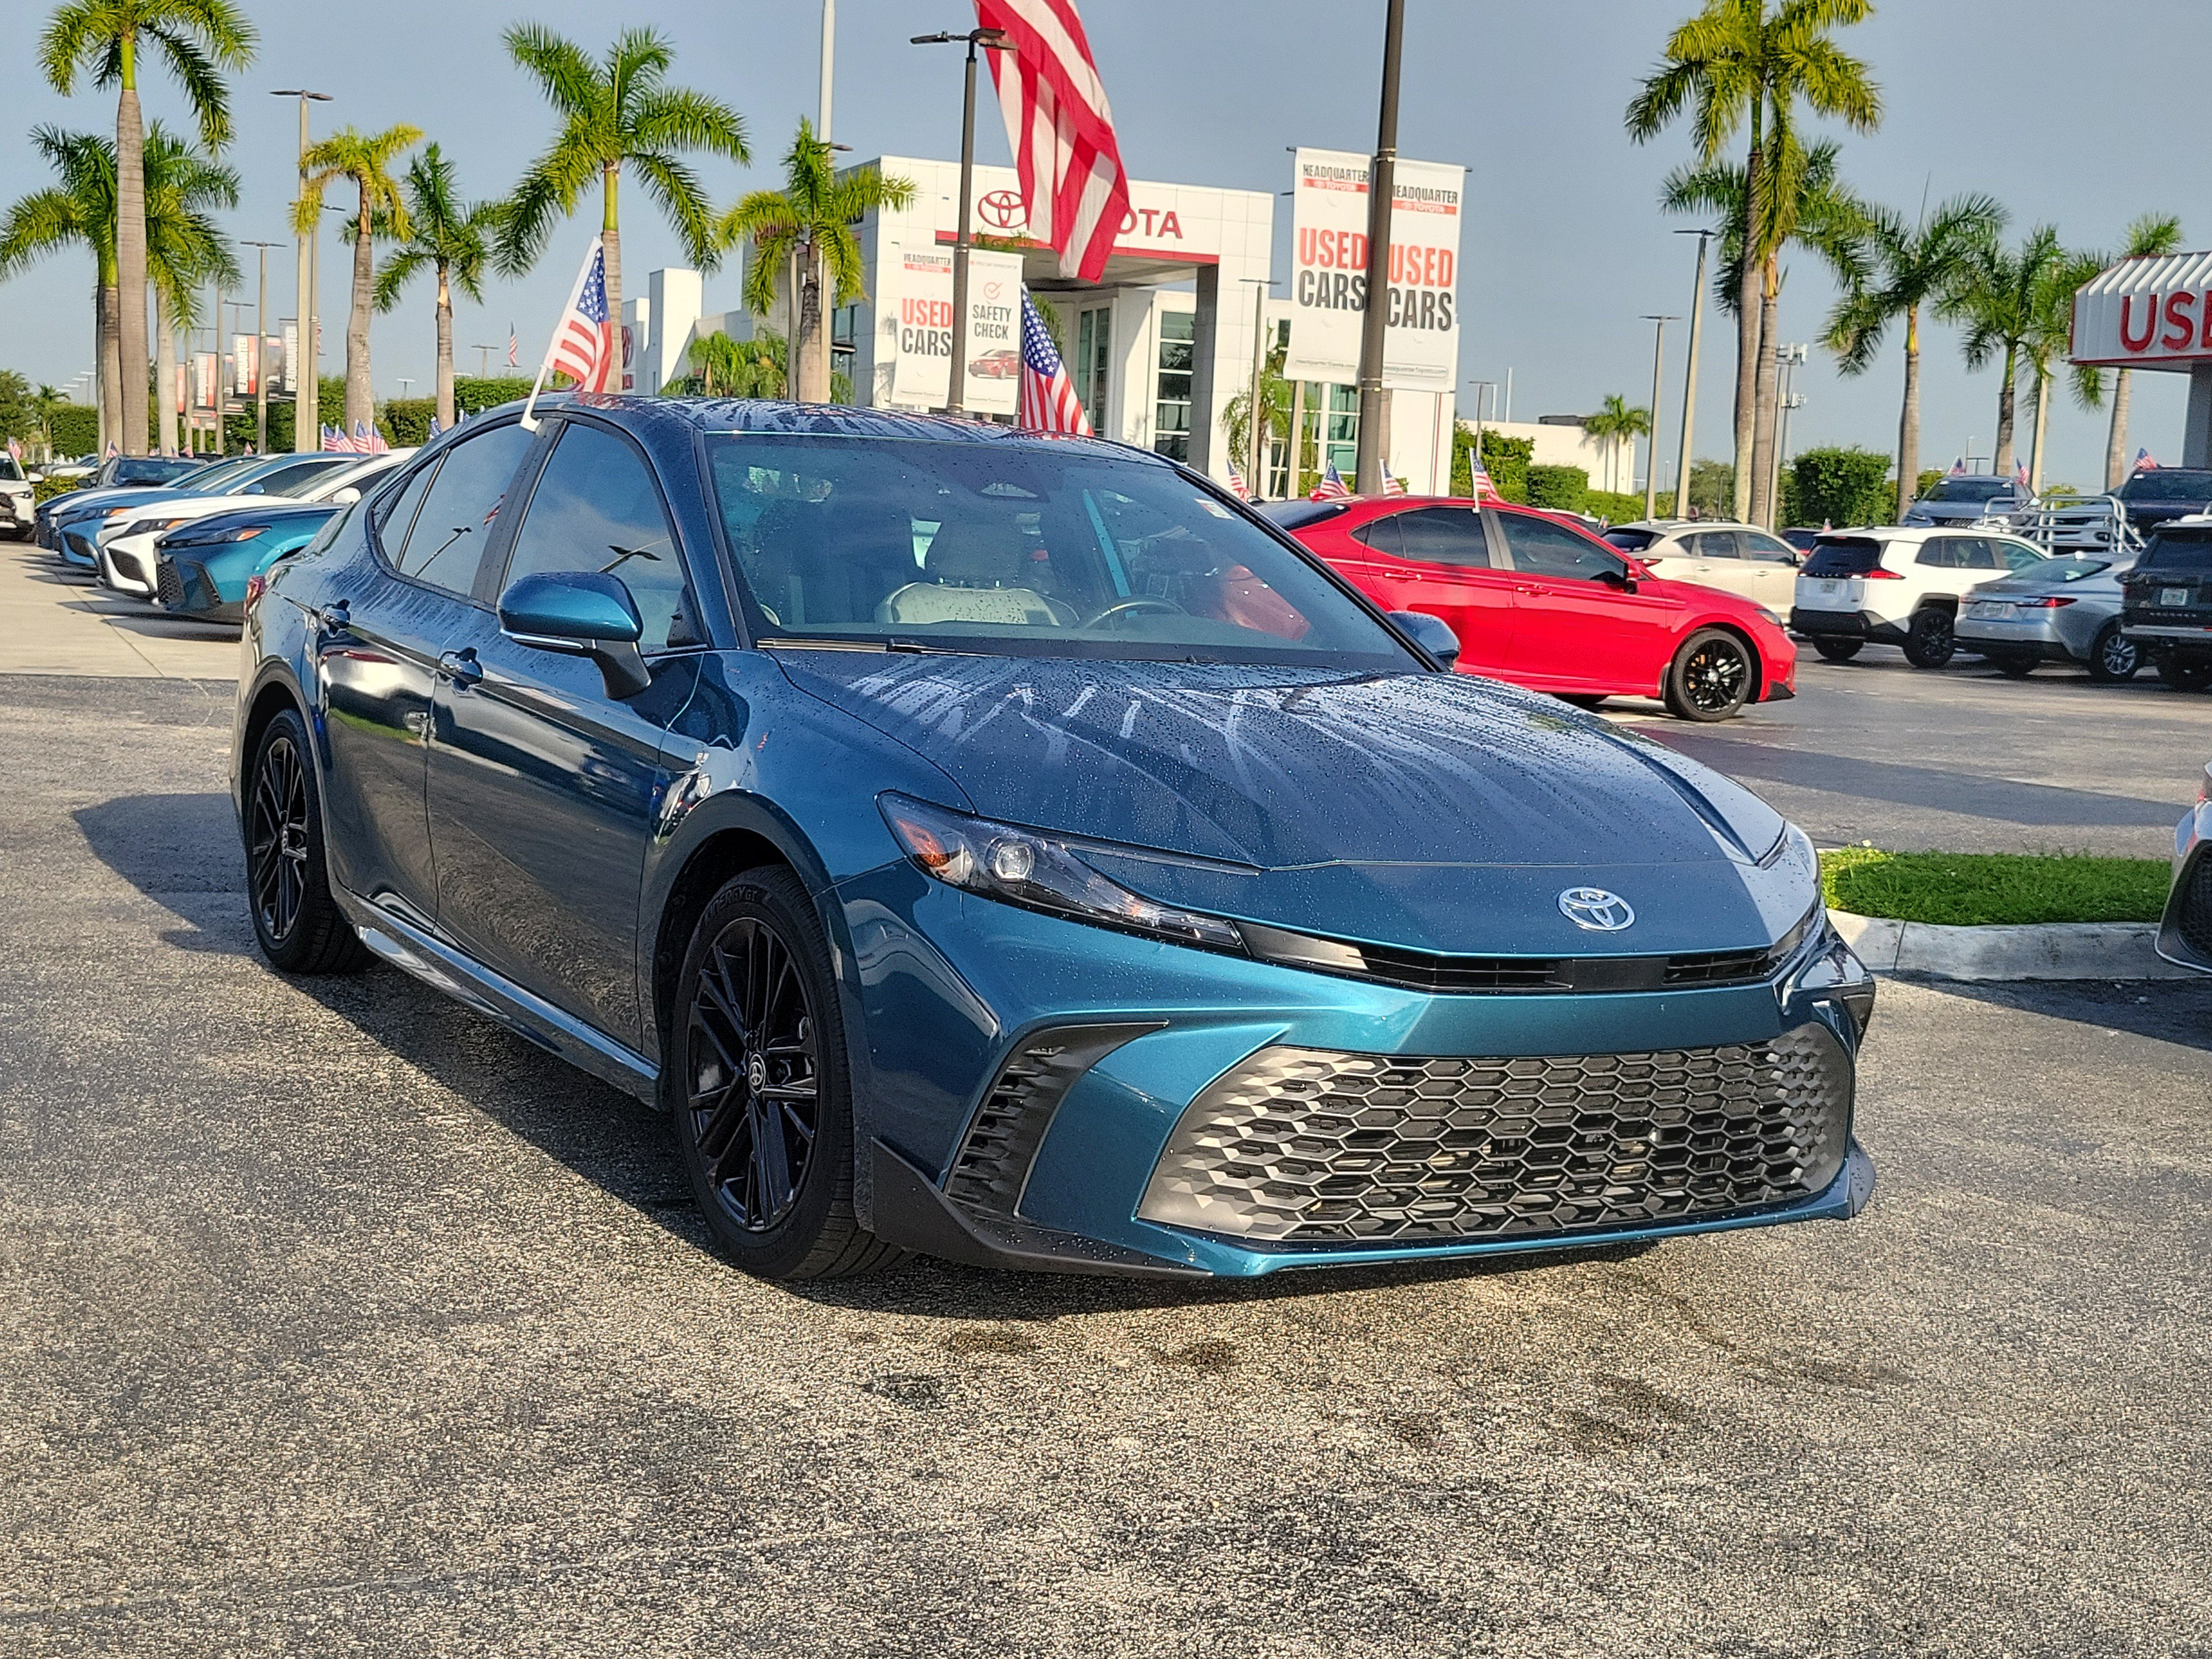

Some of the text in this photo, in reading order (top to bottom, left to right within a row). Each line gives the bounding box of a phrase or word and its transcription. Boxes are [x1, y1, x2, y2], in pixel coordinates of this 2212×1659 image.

[1303, 164, 1369, 183] HEADQUARTER
[1118, 208, 1183, 239] OTA
[1299, 227, 1368, 270] USED
[1388, 243, 1453, 287] USED
[1298, 269, 1367, 312] CARS
[902, 298, 953, 328] USED
[972, 304, 1012, 323] SAFETY
[1386, 287, 1452, 331] CARS
[901, 328, 952, 357] CARS
[974, 322, 1009, 340] CHECK
